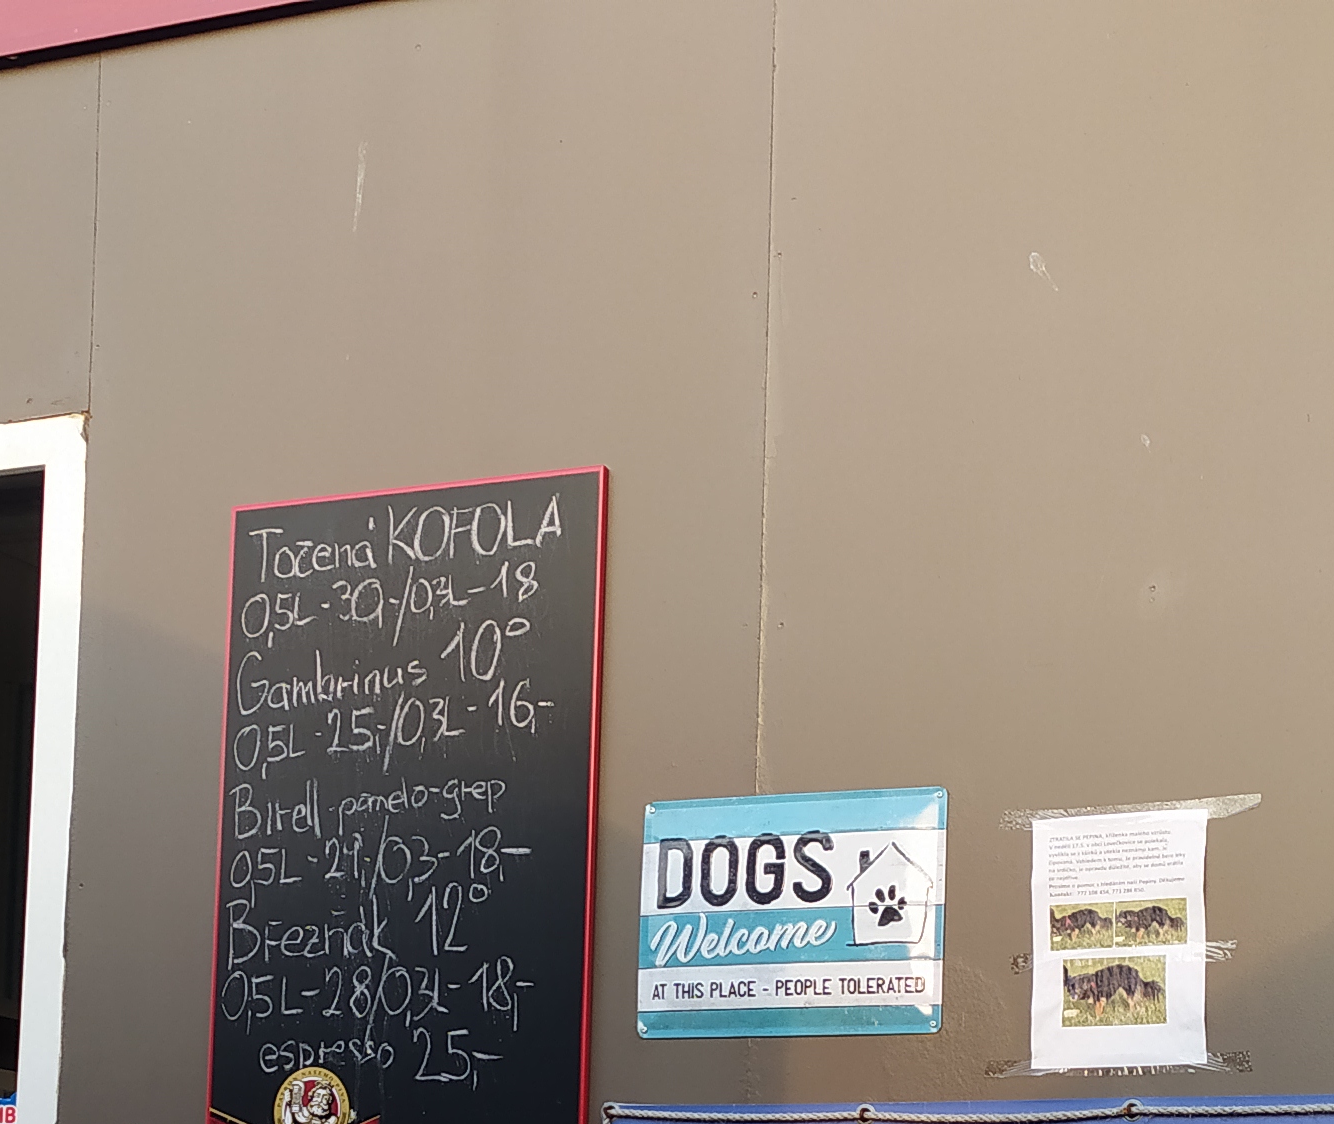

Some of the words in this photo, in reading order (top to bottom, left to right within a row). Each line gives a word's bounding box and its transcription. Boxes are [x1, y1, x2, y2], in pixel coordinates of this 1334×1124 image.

[387, 493, 562, 564] KOFOLA
[236, 650, 427, 716] Gambrinus
[229, 778, 322, 839] Birell
[656, 830, 834, 909] DOGS
[650, 912, 836, 968] Welcome
[652, 983, 668, 1000] AT
[673, 982, 704, 999] THIS
[709, 981, 757, 999] PLACE
[775, 979, 832, 997] PEOPLE
[838, 976, 925, 995] TOLERATED
[259, 1037, 394, 1072] espresso
